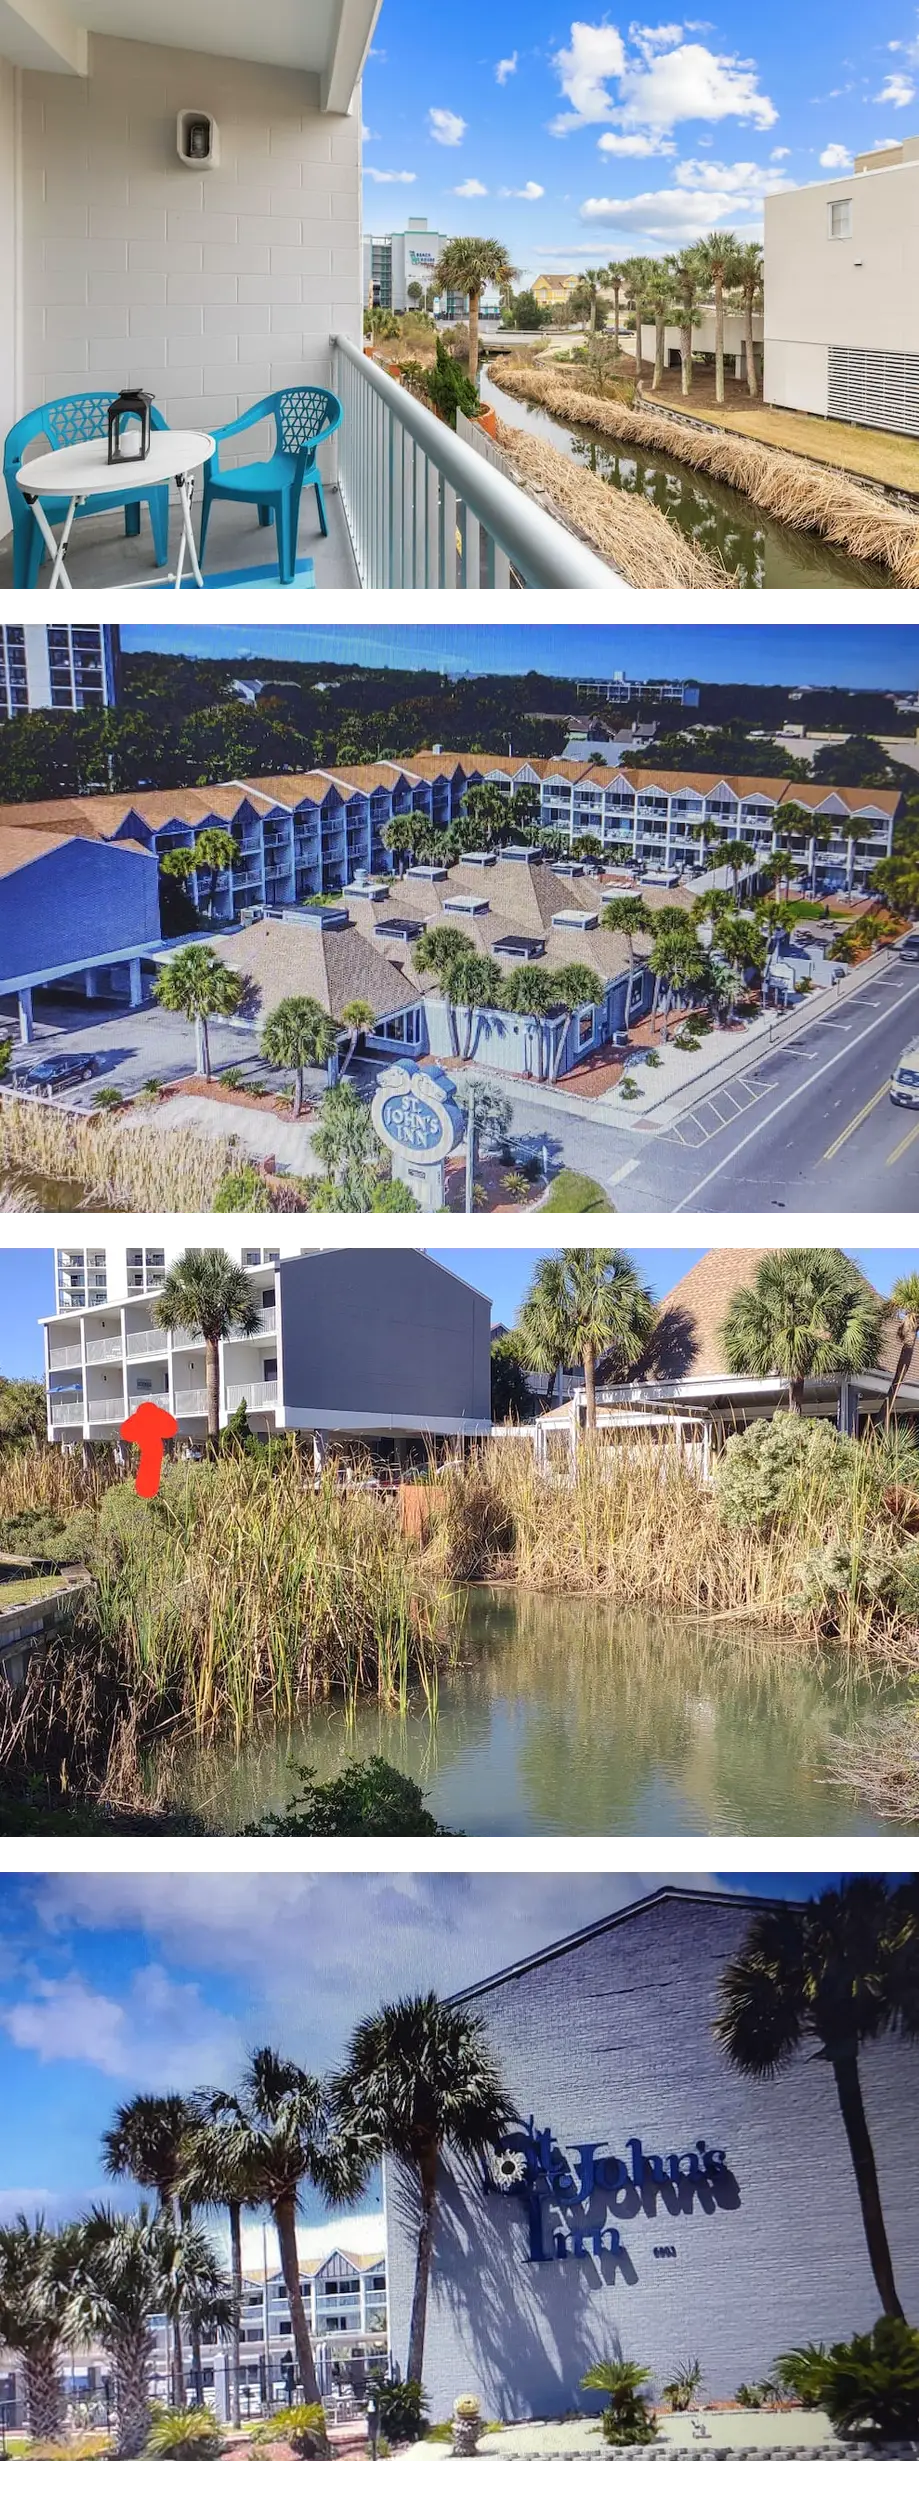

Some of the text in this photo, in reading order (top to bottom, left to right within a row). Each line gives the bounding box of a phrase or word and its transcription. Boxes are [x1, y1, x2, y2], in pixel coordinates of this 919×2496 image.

[385, 1106, 440, 1135] JOHN'S
[397, 1126, 428, 1149] INN
[552, 2138, 727, 2206] John's
[521, 2193, 621, 2263] Inn
